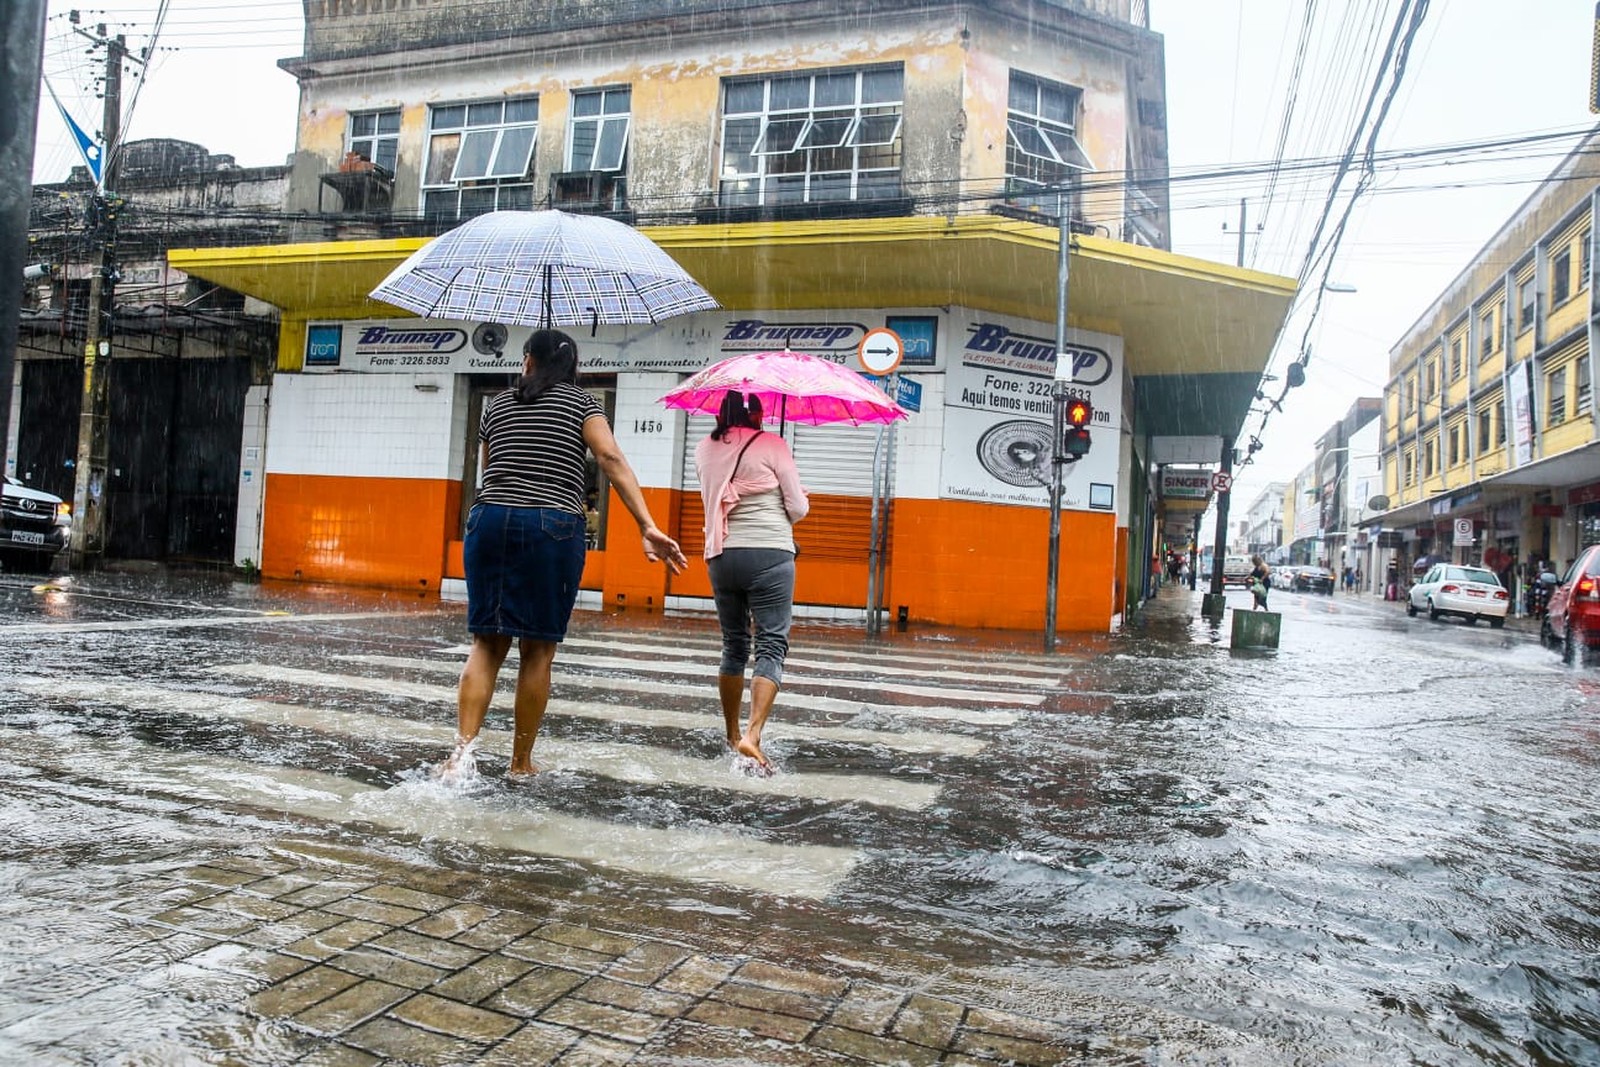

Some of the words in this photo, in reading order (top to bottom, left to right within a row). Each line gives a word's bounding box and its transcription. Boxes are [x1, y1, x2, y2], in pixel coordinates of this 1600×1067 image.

[358, 327, 456, 349] Brumap
[722, 319, 854, 347] Brumap
[370, 356, 398, 366] Fone:
[400, 356, 450, 366] 3226.5833
[468, 358, 522, 369] Ventilan
[634, 357, 710, 368] momentos!
[984, 374, 1023, 393] Fone:
[961, 387, 986, 407] Aqui
[989, 392, 1021, 410] temos
[634, 419, 663, 433] 1450
[1164, 476, 1209, 488] SINGER
